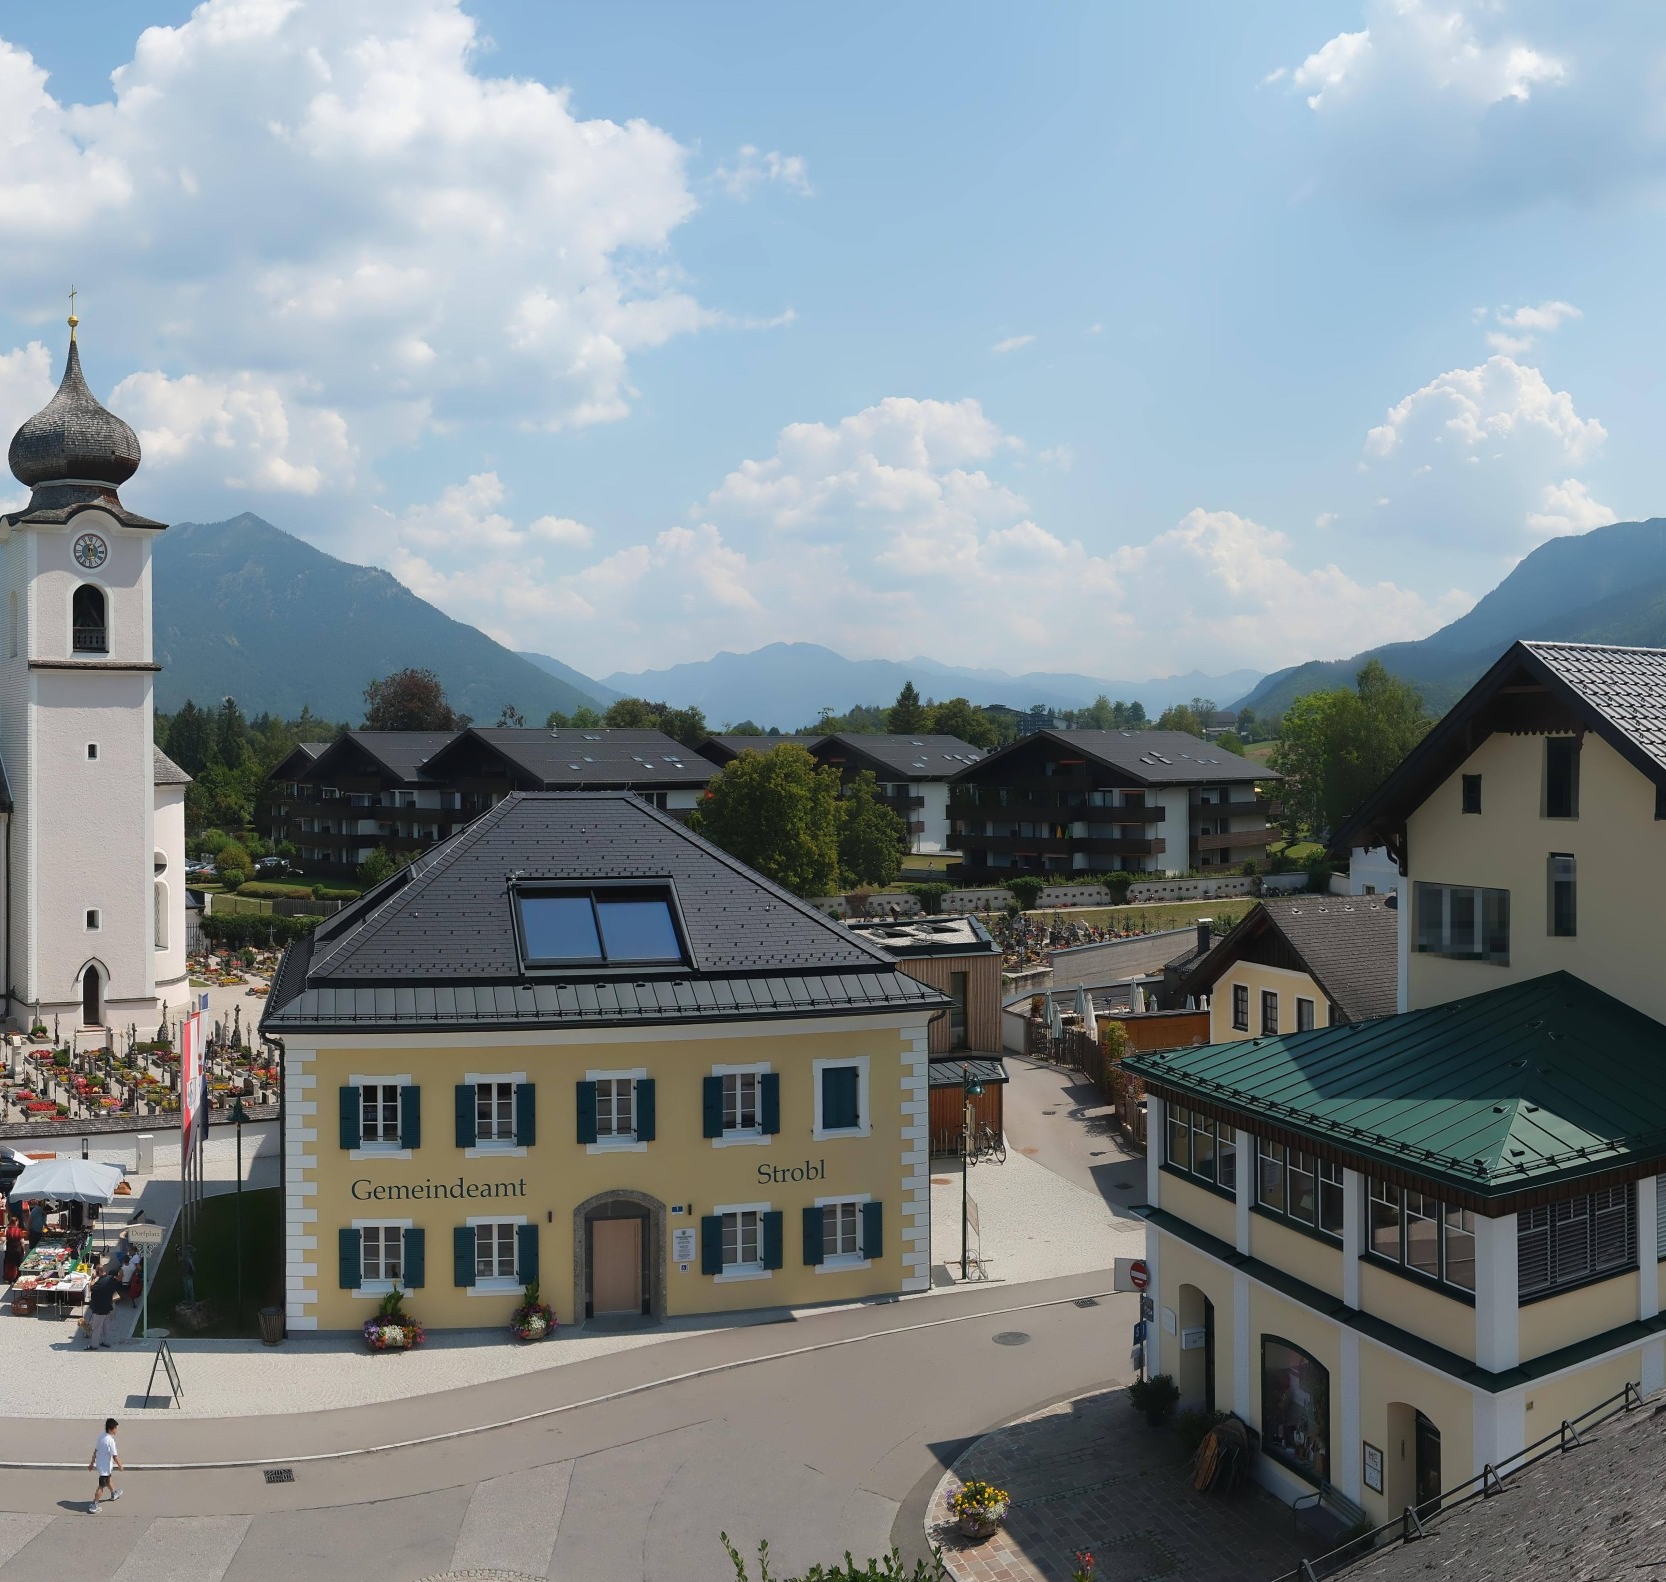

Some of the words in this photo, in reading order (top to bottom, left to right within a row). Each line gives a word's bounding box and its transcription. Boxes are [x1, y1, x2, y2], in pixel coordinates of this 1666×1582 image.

[351, 1177, 527, 1200] Gemeindeamt
[757, 1159, 826, 1184] Strobl
[131, 1229, 160, 1238] Dorfplatz
